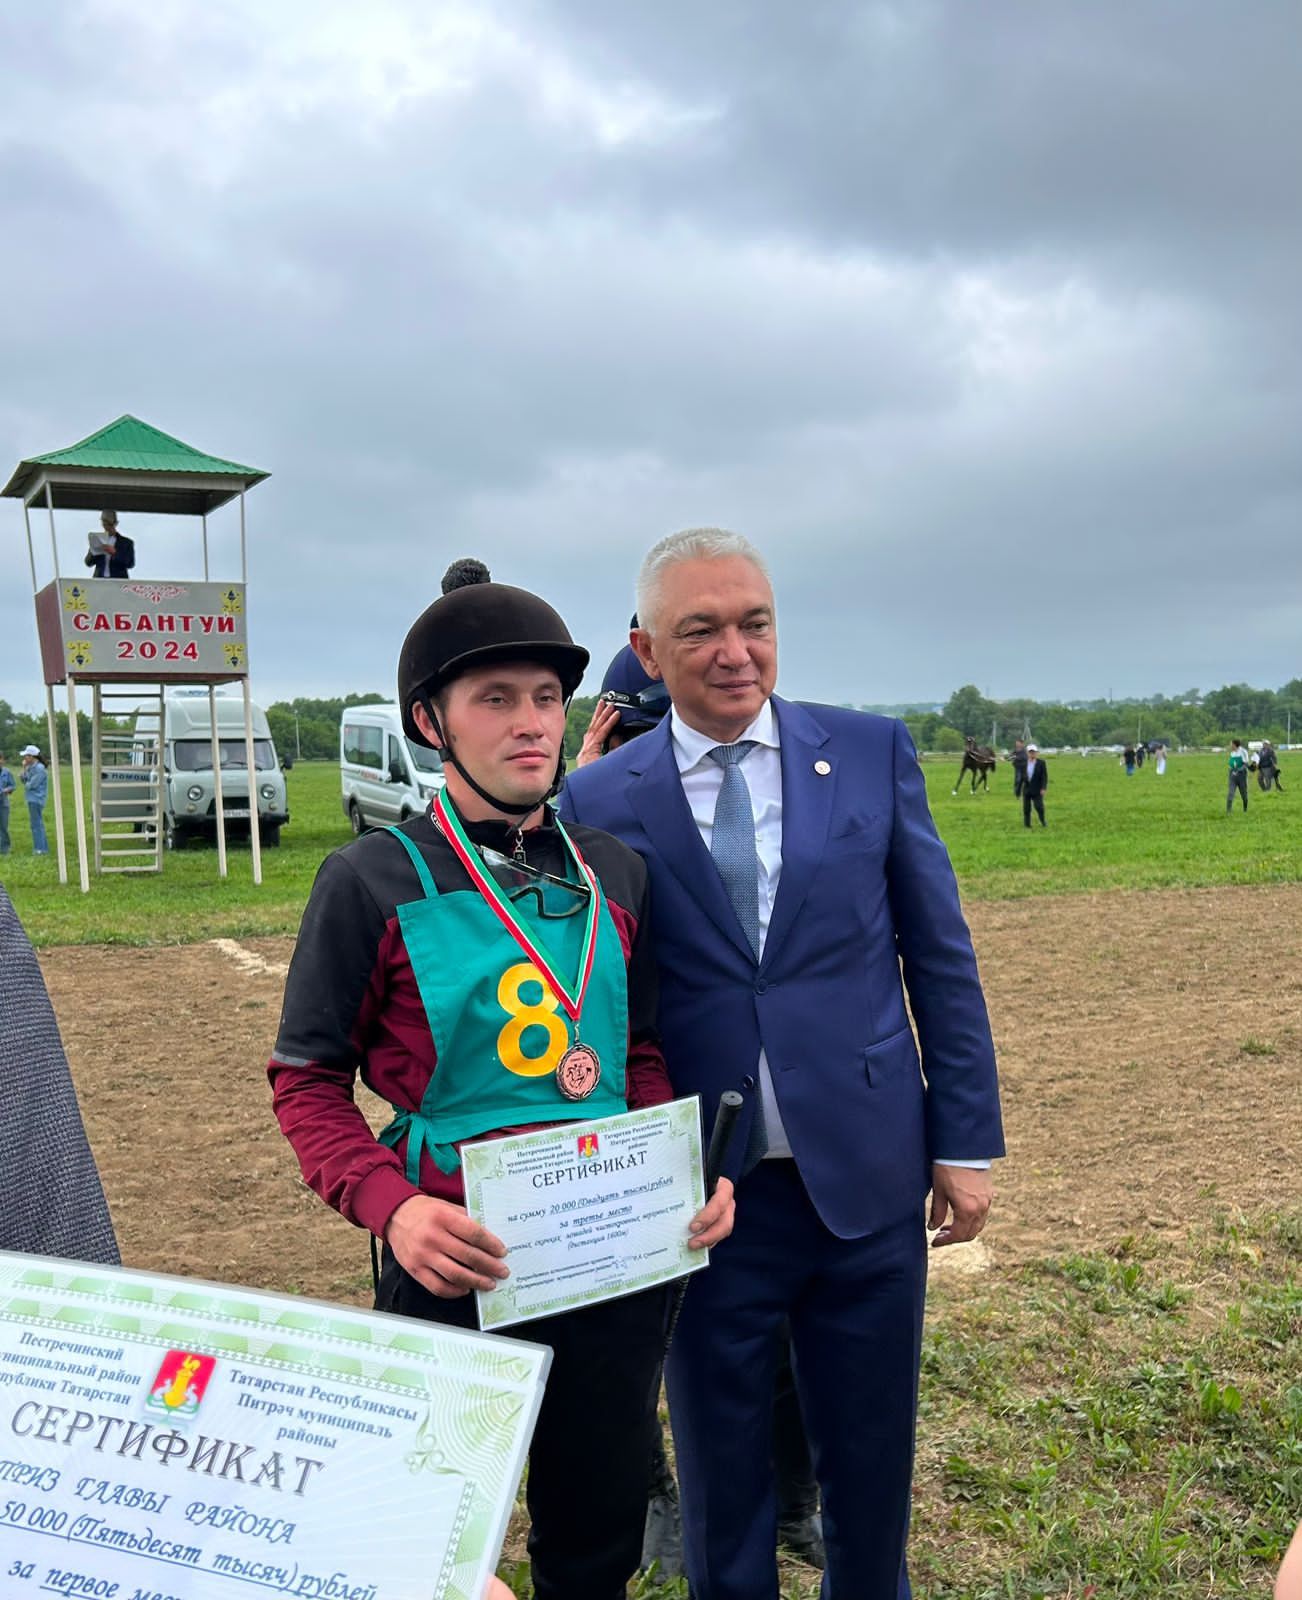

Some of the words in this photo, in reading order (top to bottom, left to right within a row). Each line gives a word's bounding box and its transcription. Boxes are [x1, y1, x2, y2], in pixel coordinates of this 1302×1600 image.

[72, 613, 235, 634] САБАНТУЙ
[117, 641, 198, 661] 2024
[497, 962, 569, 1077] 8
[532, 1150, 648, 1189] СЕРТИФИКАТ
[508, 1214, 518, 1223] на
[520, 1208, 546, 1222] сумму
[551, 1203, 560, 1215] 20
[562, 1200, 577, 1210] 000
[19, 1332, 125, 1361] Пестречинский
[0, 1351, 98, 1377] ниципальный
[98, 1368, 142, 1385] район
[0, 1371, 57, 1391] публики
[60, 1379, 132, 1405] Татарстан
[229, 1369, 305, 1397] Татарстан
[308, 1385, 418, 1422] Республикасы
[276, 1426, 338, 1449] районы
[298, 1409, 394, 1439] муниципаль
[11, 1400, 326, 1496] СЕРТИФИКАТ
[0, 1460, 61, 1492] ПРИЗ
[74, 1477, 172, 1514] ГЛАВЫ
[184, 1501, 297, 1545] РАЙОНА
[0, 1501, 26, 1522] 50
[28, 1506, 68, 1531] 000
[67, 1513, 203, 1564] (Пятьдесят
[8, 1560, 37, 1579] за
[45, 1567, 120, 1600] первое
